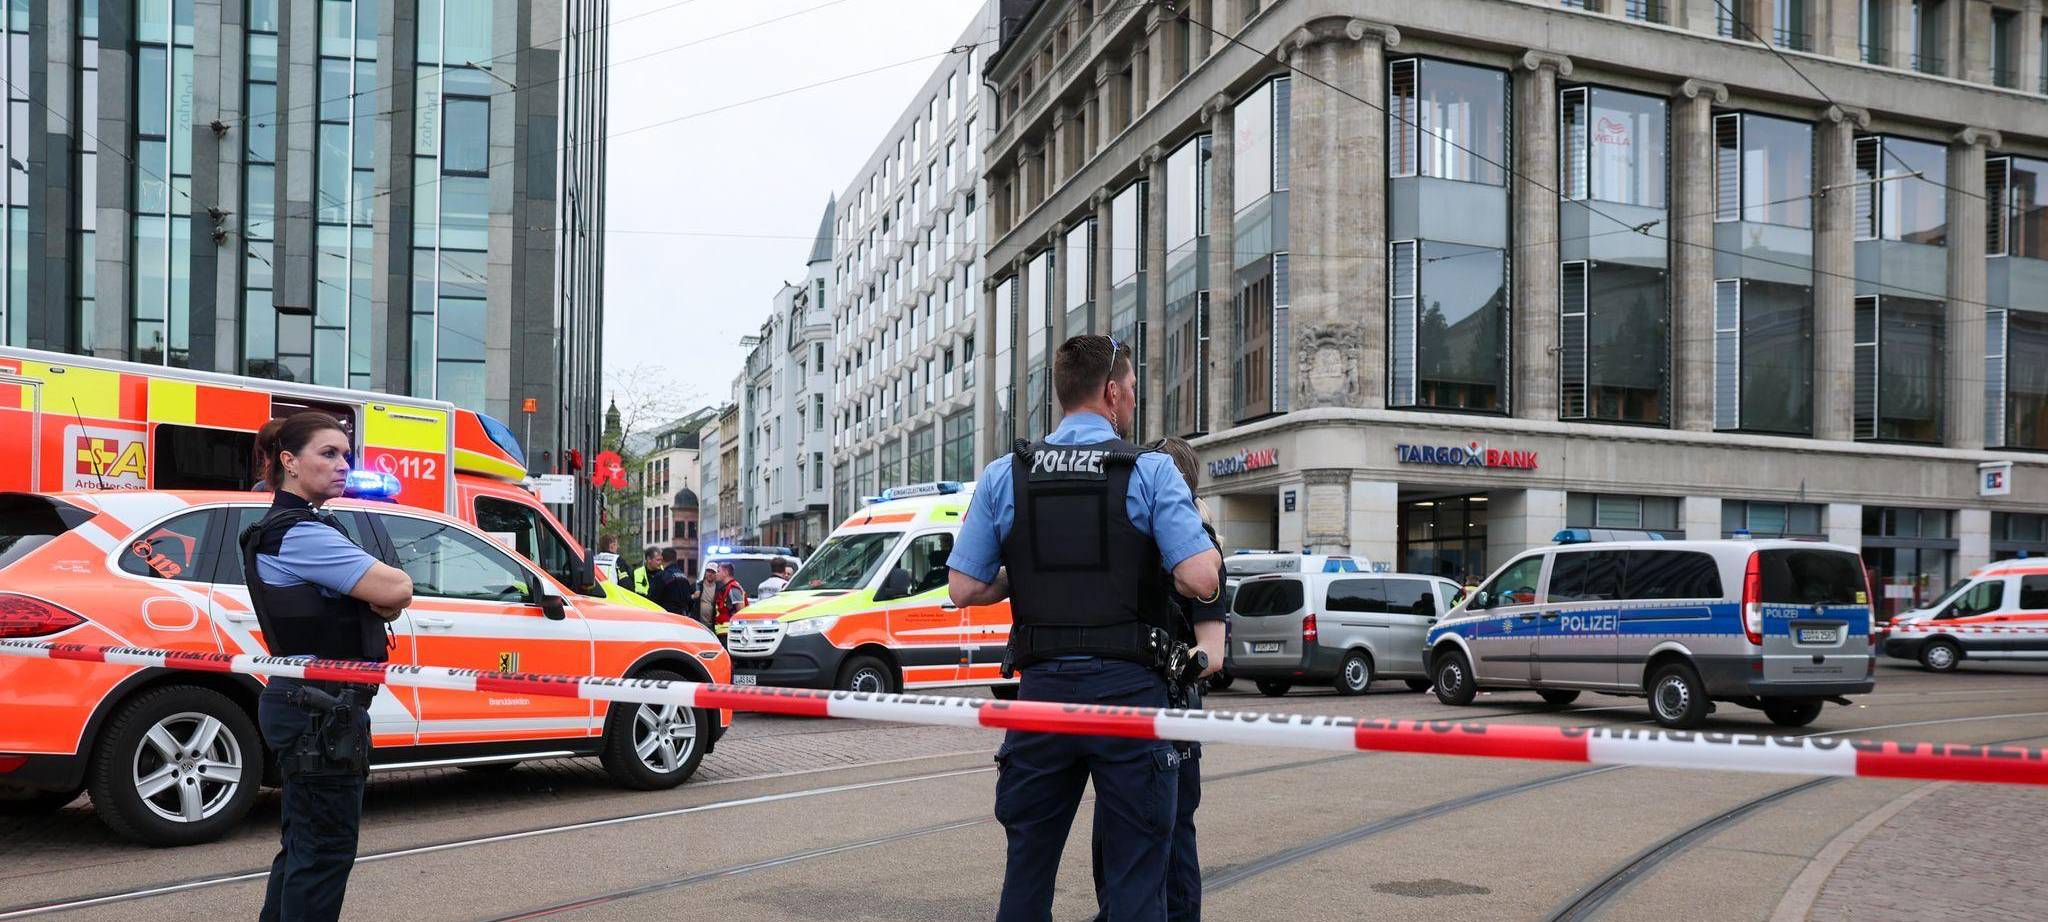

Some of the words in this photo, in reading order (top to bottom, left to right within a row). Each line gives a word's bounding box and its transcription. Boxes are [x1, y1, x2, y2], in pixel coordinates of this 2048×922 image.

[1594, 131, 1632, 146] WELLA
[1396, 444, 1464, 465] TARGO
[1486, 448, 1538, 468] BANK
[400, 456, 436, 480] 112
[146, 553, 182, 579] 112
[1765, 608, 1799, 618] POLIZEI
[1560, 615, 1617, 632] POLIZEI
